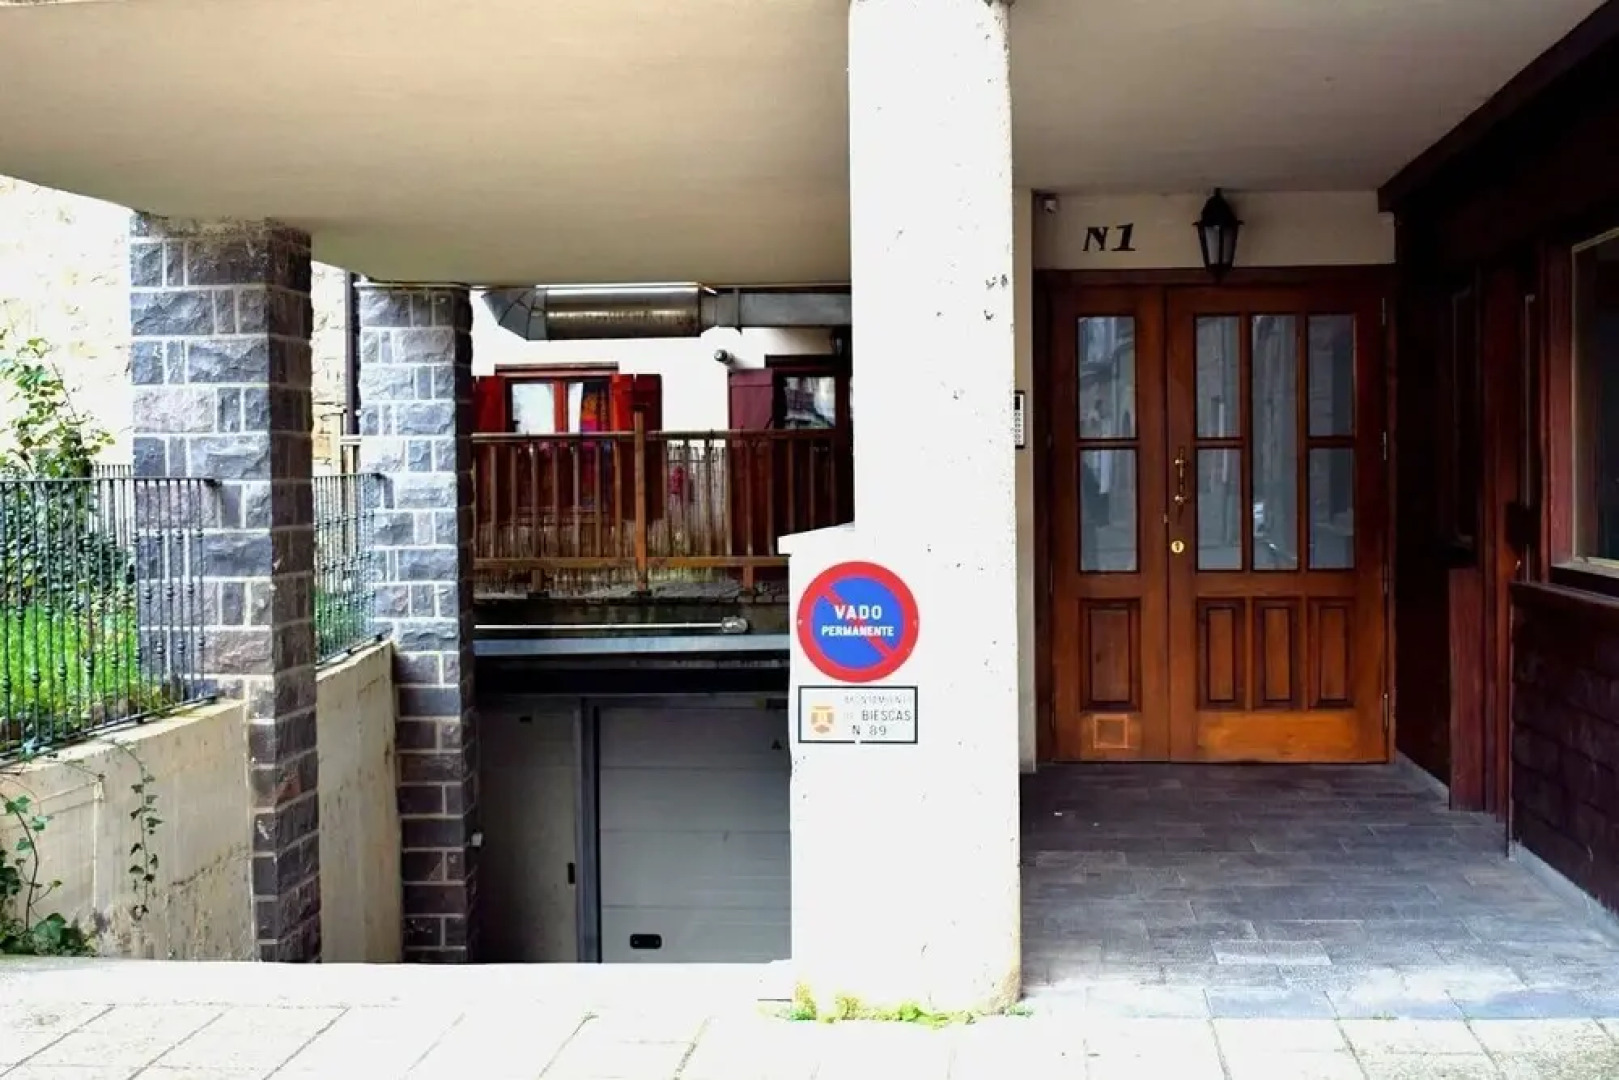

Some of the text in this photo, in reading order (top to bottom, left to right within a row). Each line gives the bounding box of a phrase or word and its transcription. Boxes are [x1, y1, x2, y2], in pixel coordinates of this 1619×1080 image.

[834, 605, 882, 619] VADO
[821, 625, 894, 637] PERMANENTE
[861, 709, 912, 721] BIESCAS
[869, 725, 886, 735] 89
